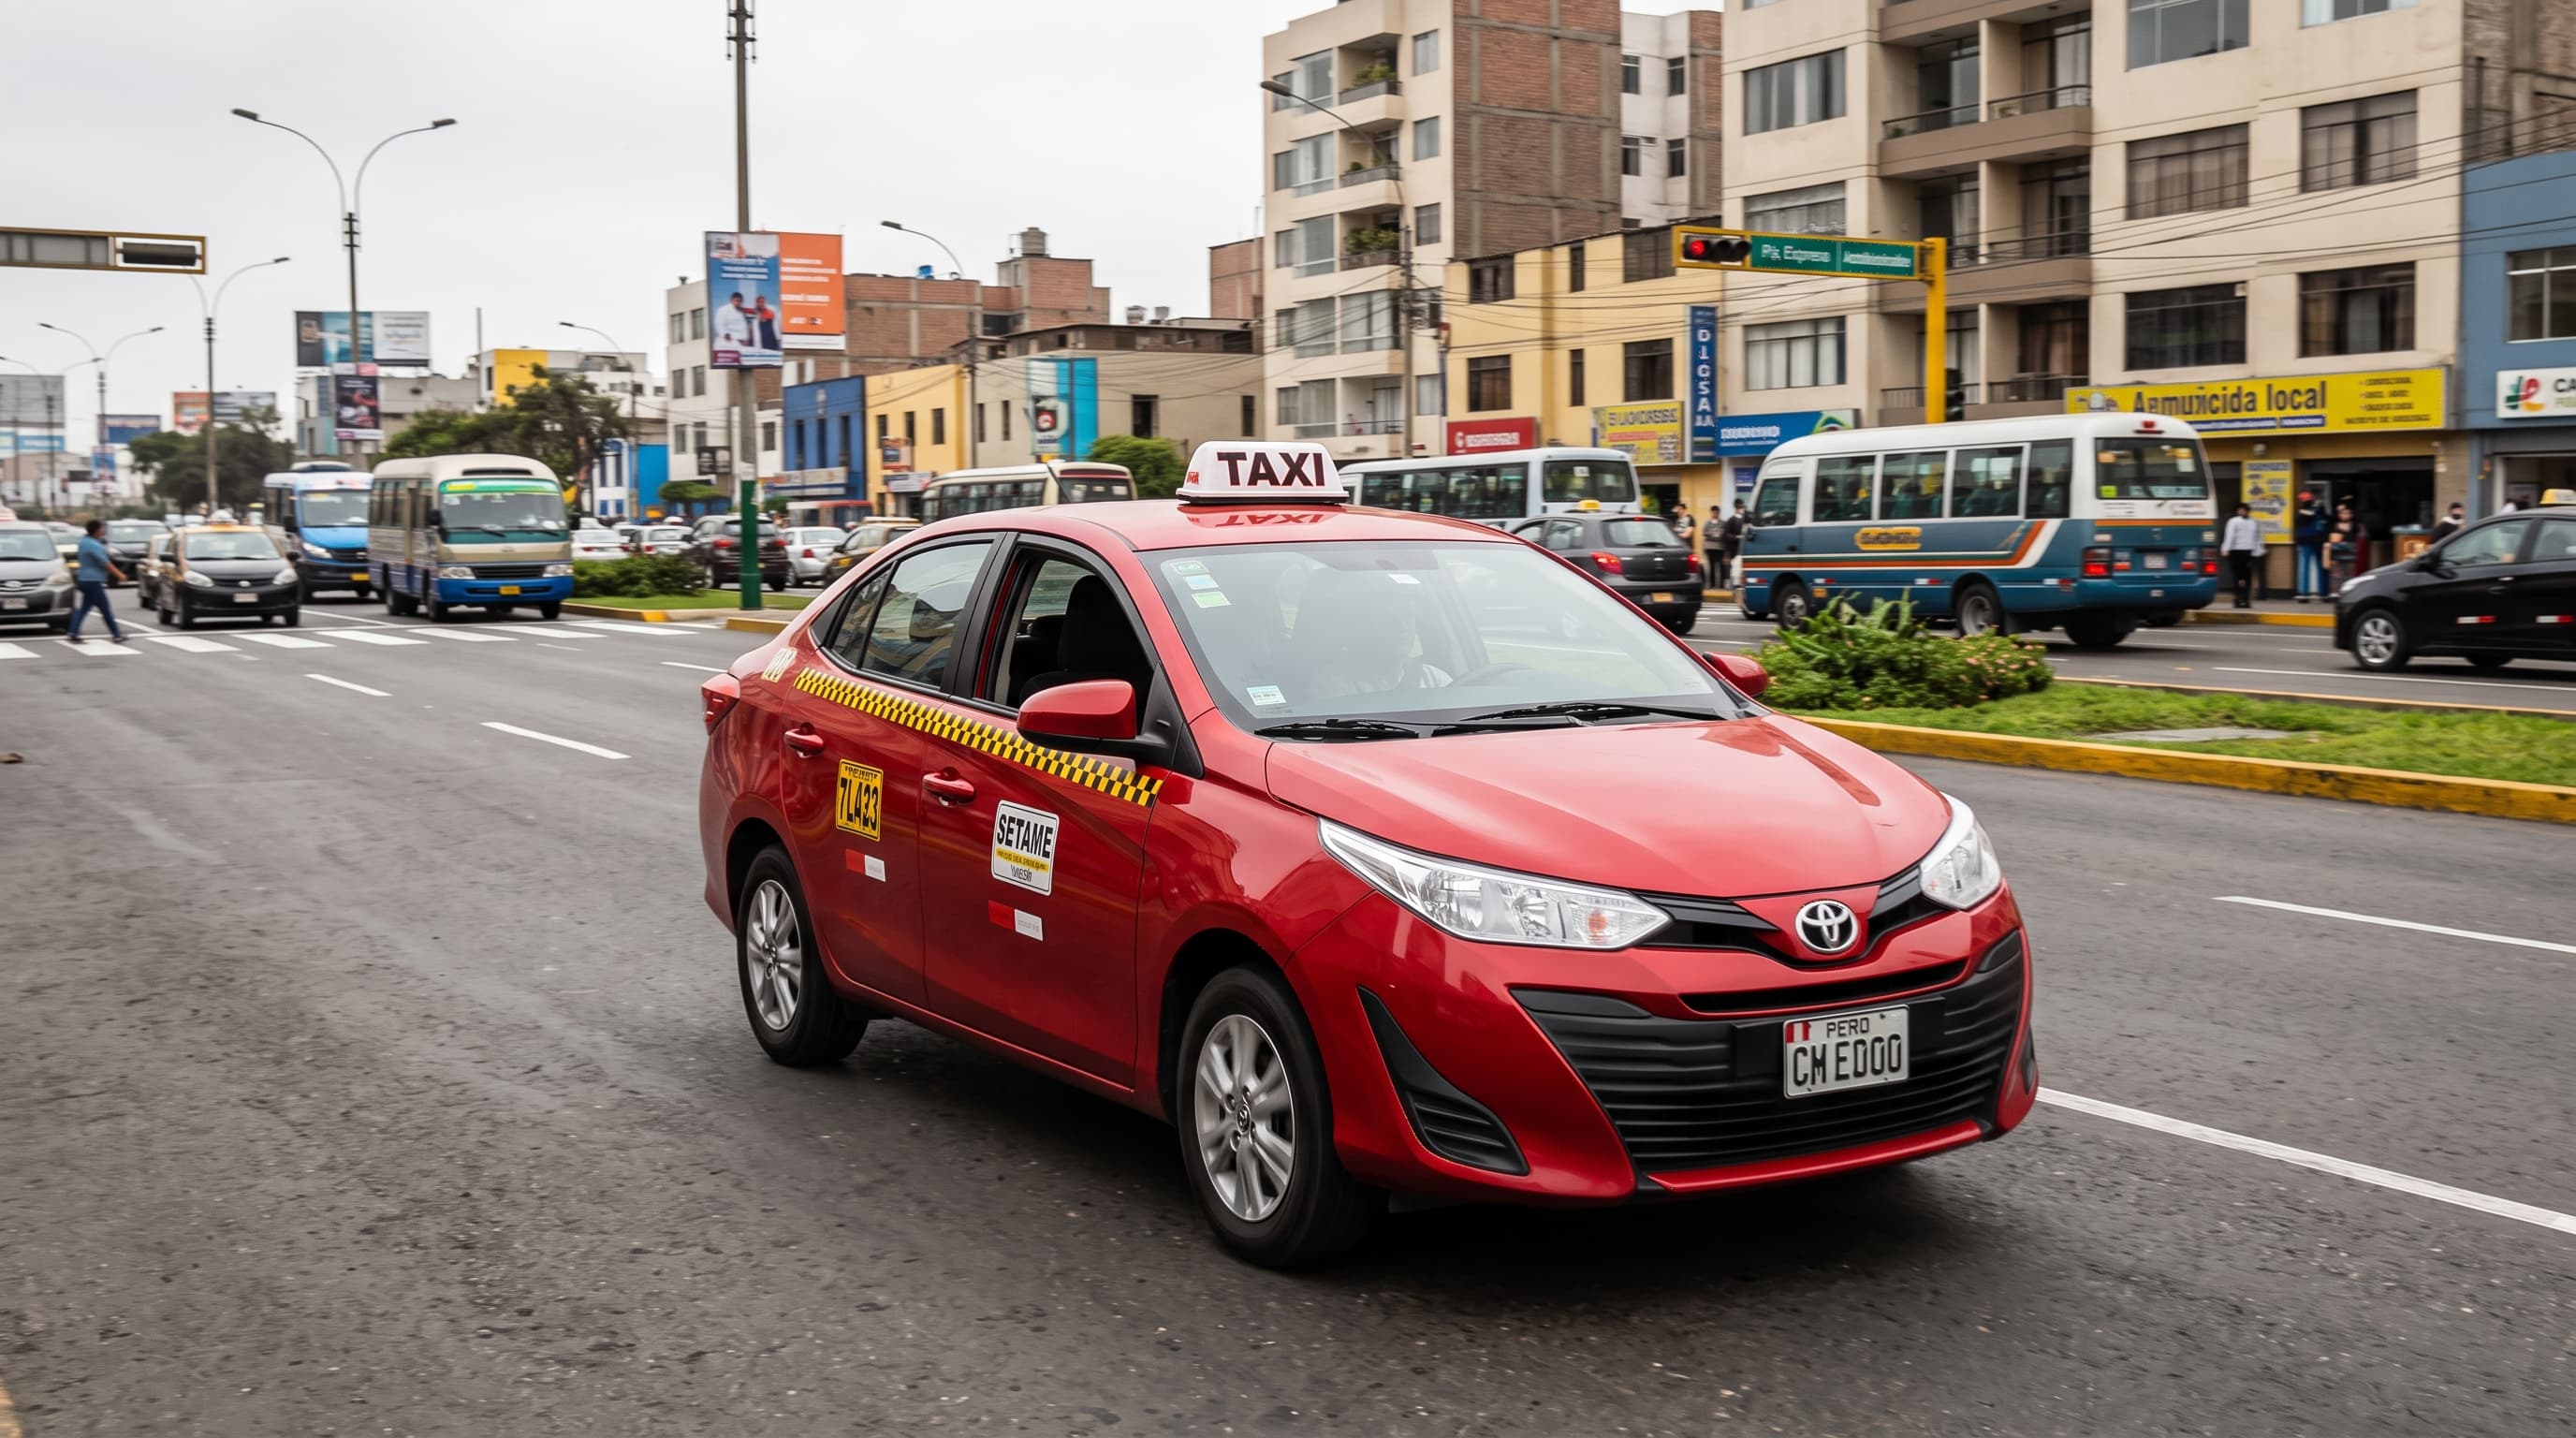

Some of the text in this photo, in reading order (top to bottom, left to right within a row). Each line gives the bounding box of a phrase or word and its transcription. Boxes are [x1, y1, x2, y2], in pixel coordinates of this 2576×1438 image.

[2267, 380, 2326, 410] local
[1217, 451, 1325, 488] TAXI
[997, 814, 1054, 859] SETAME
[1793, 1044, 1827, 1087] CM
